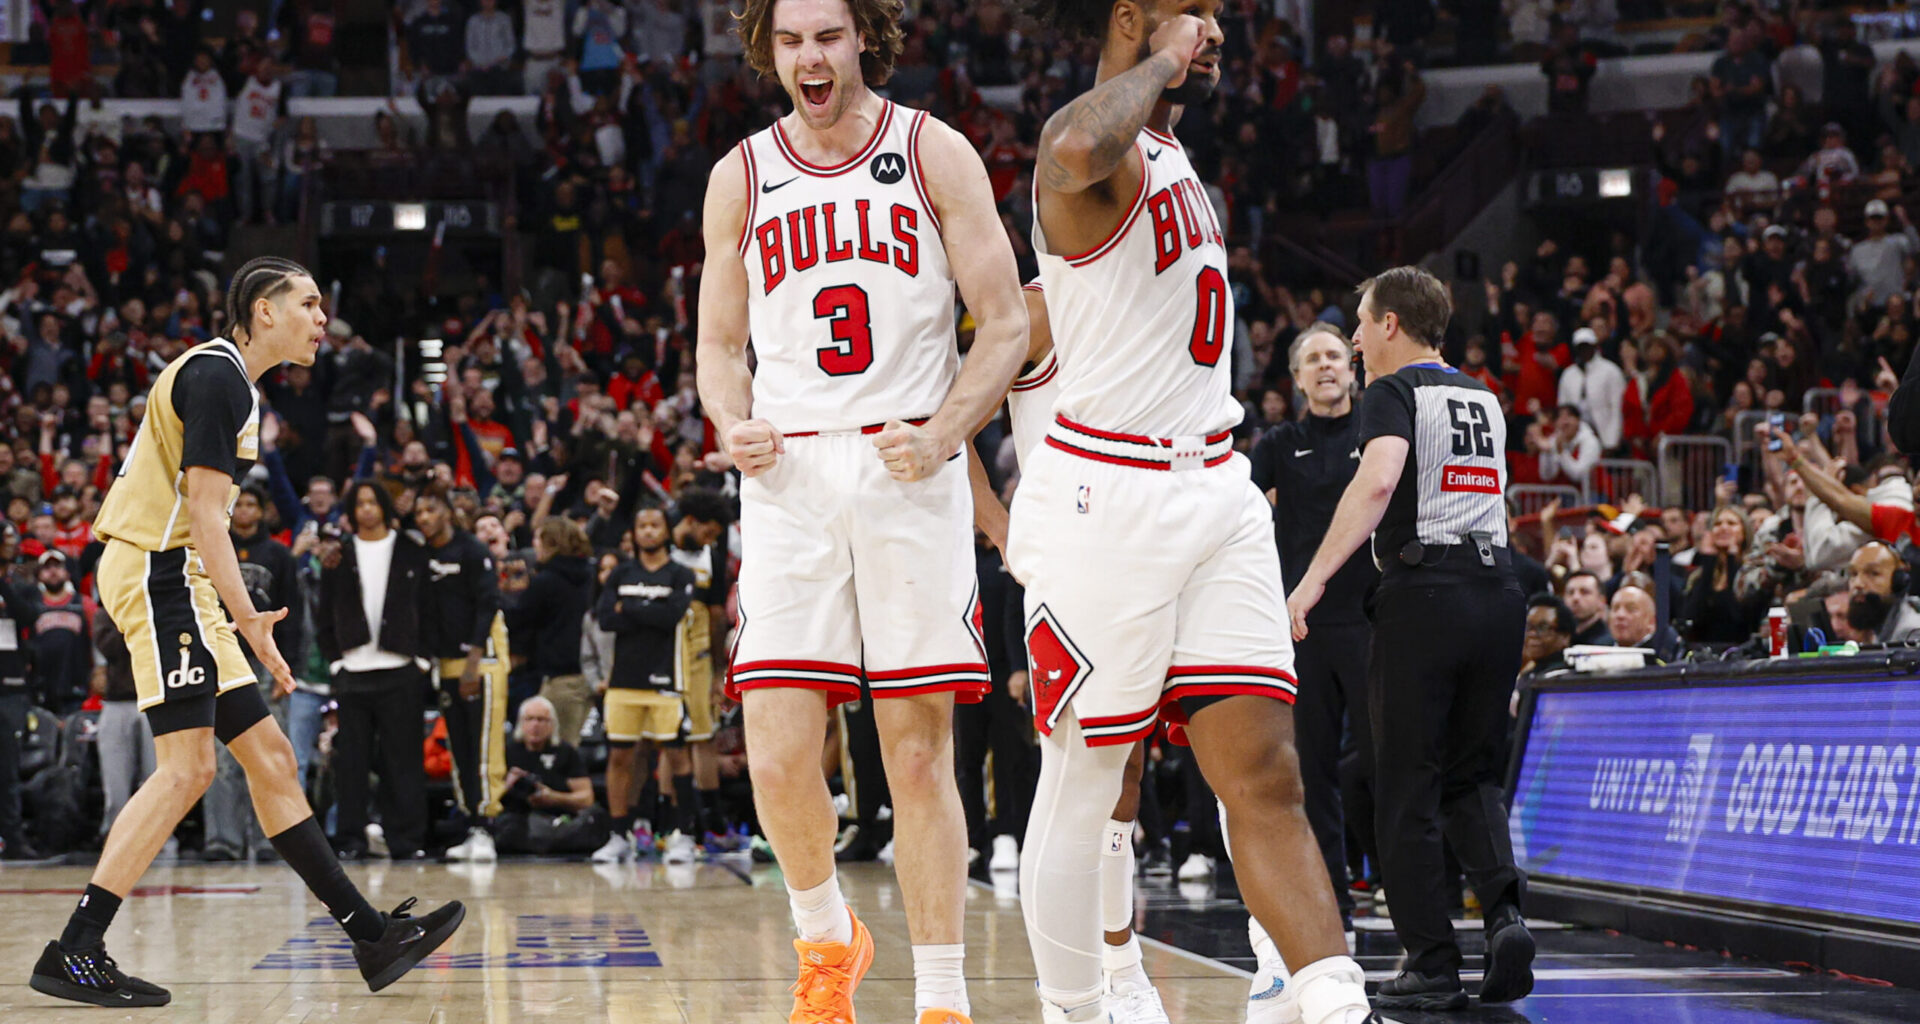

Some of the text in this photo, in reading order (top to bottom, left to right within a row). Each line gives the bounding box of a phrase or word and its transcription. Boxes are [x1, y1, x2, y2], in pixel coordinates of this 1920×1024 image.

[756, 199, 919, 297] BULLS
[812, 283, 874, 377] 3
[1188, 264, 1226, 368] 0
[1447, 398, 1495, 459] 52
[1447, 471, 1496, 488] Emirates
[167, 646, 206, 689] dc
[1590, 758, 1676, 814] UNITED
[1725, 742, 1814, 835] GOOD
[1803, 743, 1908, 845] LEADS
